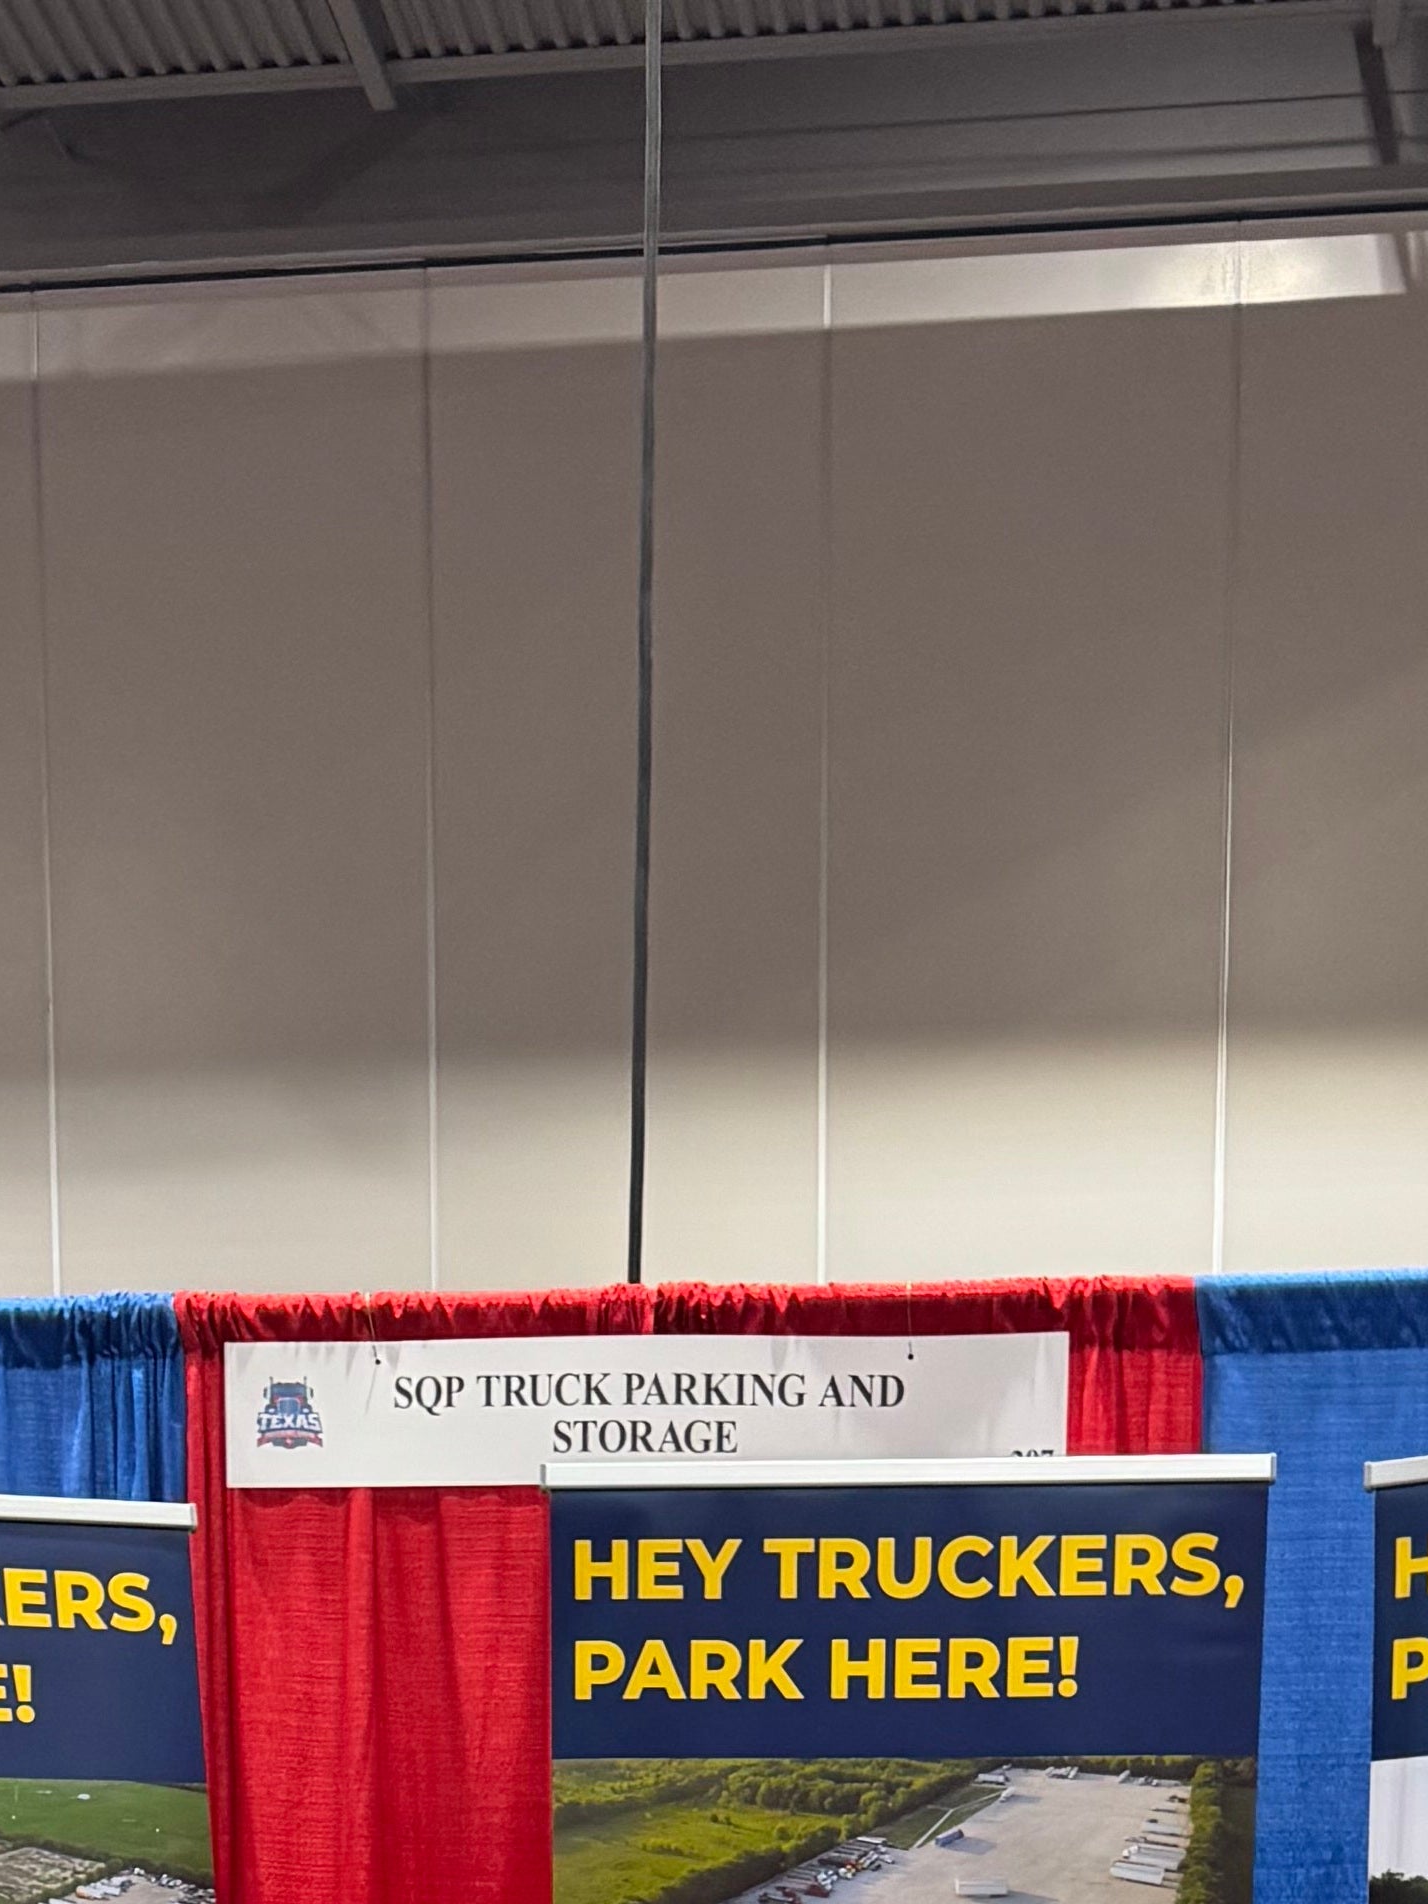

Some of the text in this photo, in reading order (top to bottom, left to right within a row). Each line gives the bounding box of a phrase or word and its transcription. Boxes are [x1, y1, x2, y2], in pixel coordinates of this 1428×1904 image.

[394, 1372, 906, 1416] SQP TRUCK PARKING AND
[257, 1413, 321, 1432] TEXAS
[553, 1419, 739, 1454] STORAGE
[573, 1532, 1245, 1608] HEY TRUCKERS,
[573, 1636, 1079, 1701] PARK HERE!
